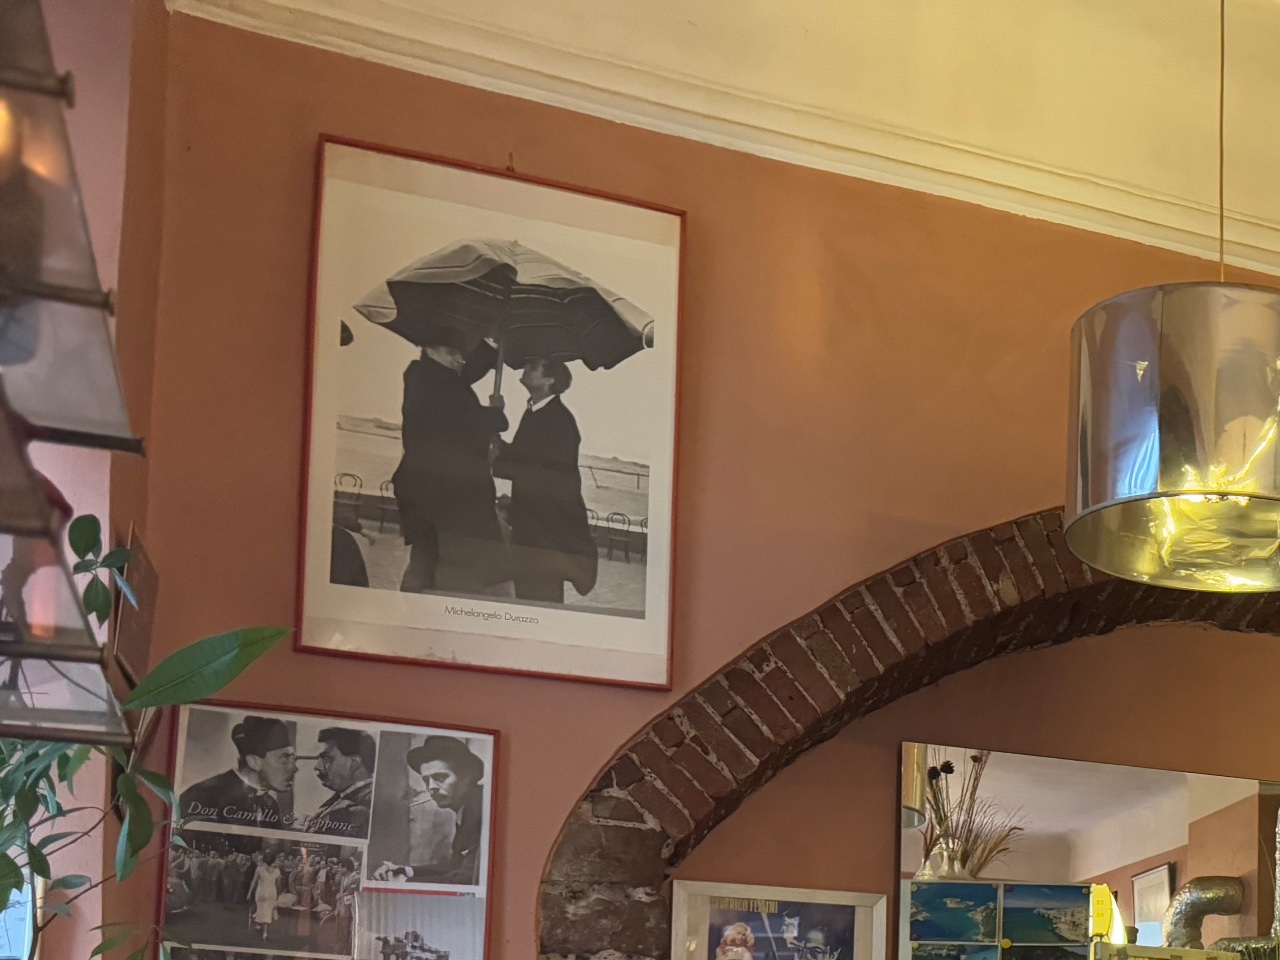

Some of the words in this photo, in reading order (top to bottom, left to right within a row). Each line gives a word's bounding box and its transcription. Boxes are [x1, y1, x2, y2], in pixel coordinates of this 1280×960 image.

[445, 606, 502, 620] Michelangelo
[504, 612, 539, 624] Durazzo
[188, 801, 218, 816] Don
